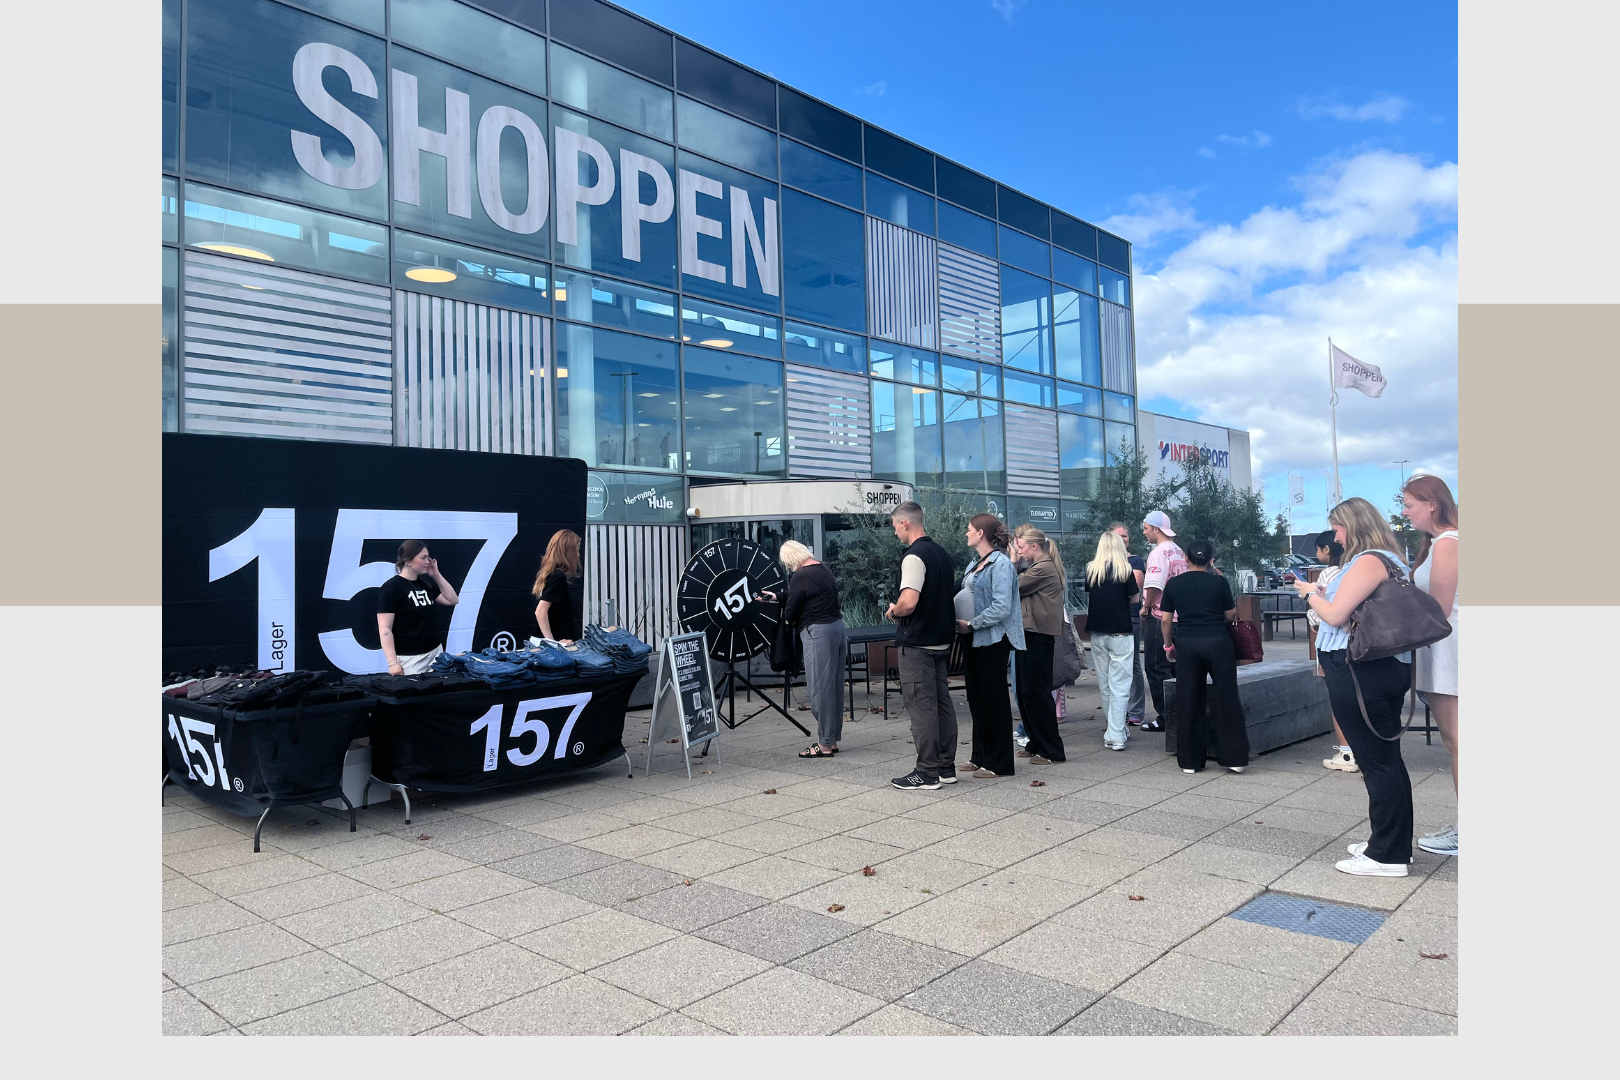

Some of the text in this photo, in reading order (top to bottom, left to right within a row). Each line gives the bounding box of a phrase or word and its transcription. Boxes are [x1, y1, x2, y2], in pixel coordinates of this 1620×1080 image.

[290, 41, 780, 298] SHOPPEN
[1342, 362, 1383, 383] SHOPPEN
[648, 496, 673, 509] Hule
[866, 492, 902, 505] SHOPPEN
[704, 546, 716, 558] 157
[209, 507, 518, 676] 157
[407, 589, 432, 607] 157
[714, 575, 753, 620] 157
[271, 621, 288, 671] Lager
[674, 640, 699, 654] SPIN THE
[676, 654, 696, 666] WHEEL
[702, 708, 713, 725] 157
[470, 692, 592, 772] 157
[168, 714, 231, 791] 157
[487, 747, 496, 767] Lager
